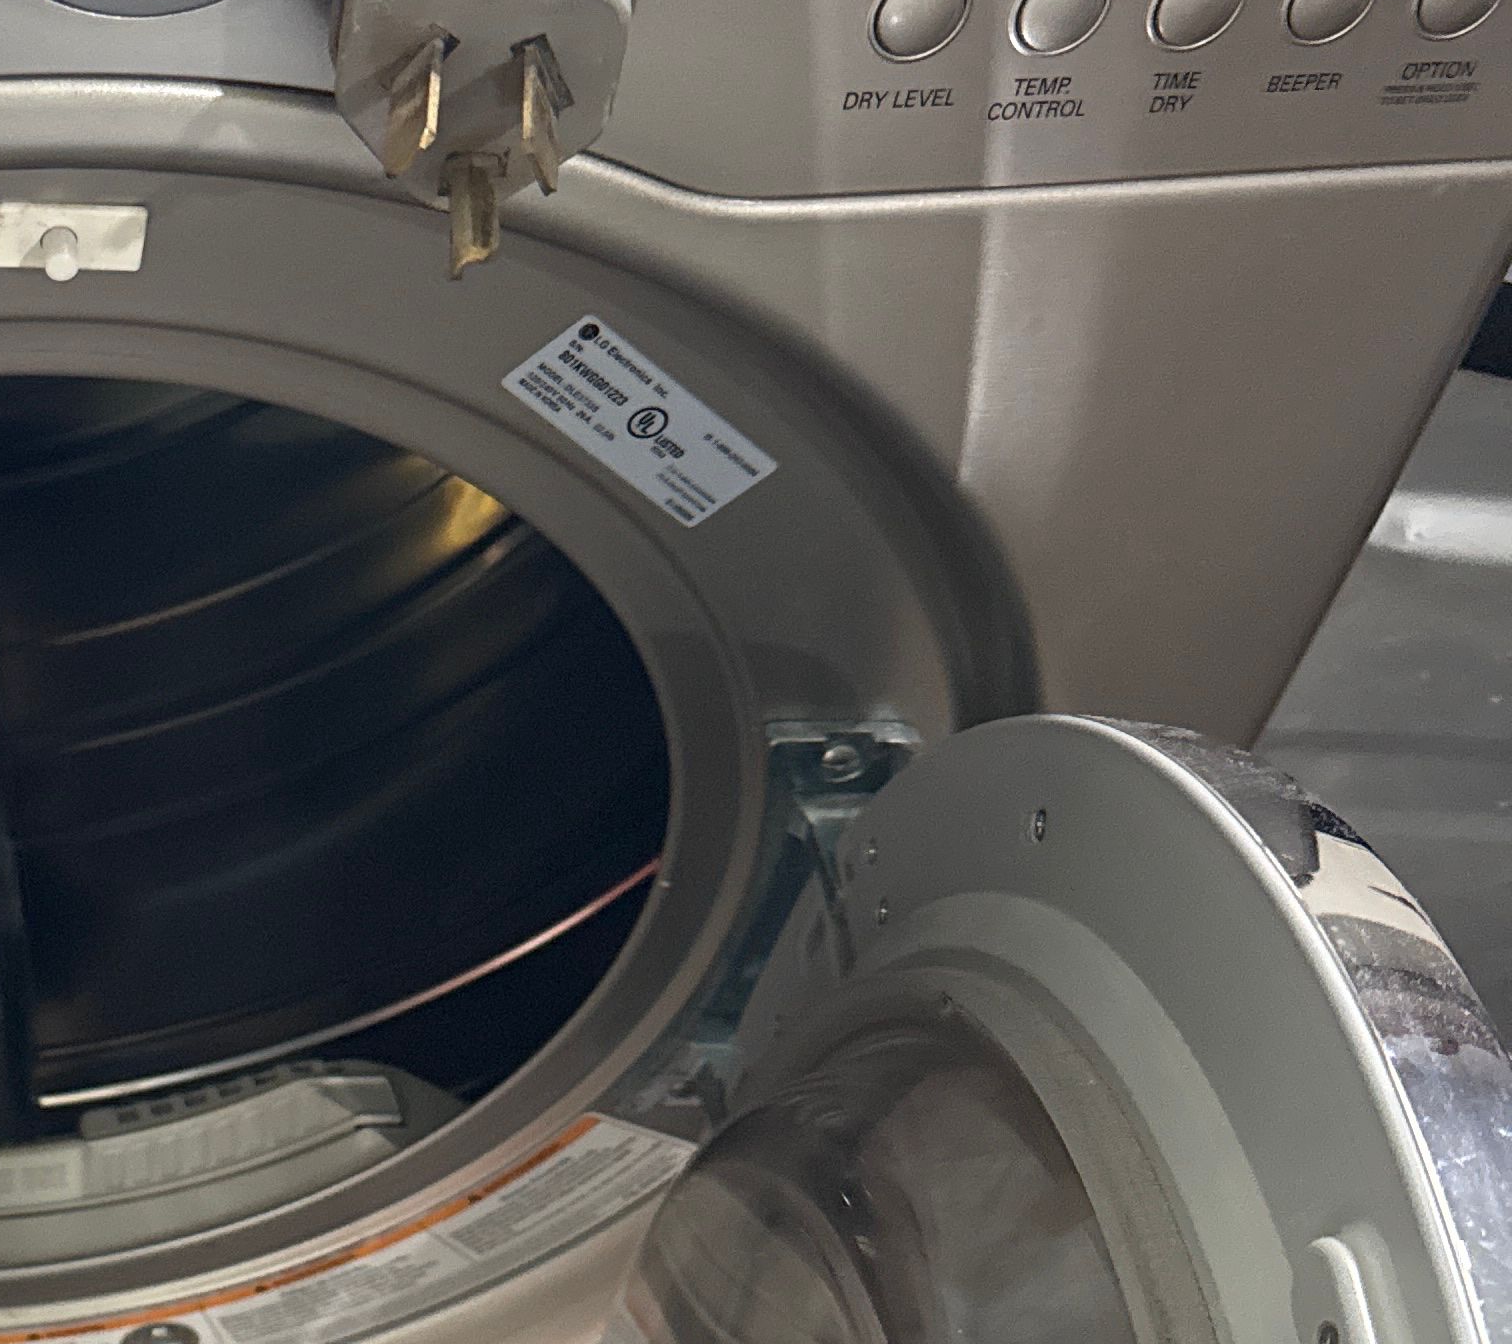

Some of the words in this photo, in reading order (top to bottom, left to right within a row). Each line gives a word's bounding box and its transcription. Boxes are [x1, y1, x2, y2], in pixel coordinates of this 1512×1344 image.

[1154, 72, 1202, 90] TIME
[1401, 62, 1477, 81] OPTION
[1014, 78, 1072, 96] TEMP.
[1267, 73, 1343, 93] BEEPER
[843, 91, 889, 110] DRY
[892, 88, 955, 108] LEVEL
[1149, 95, 1193, 114] DRY
[988, 100, 1085, 121] CONTROL
